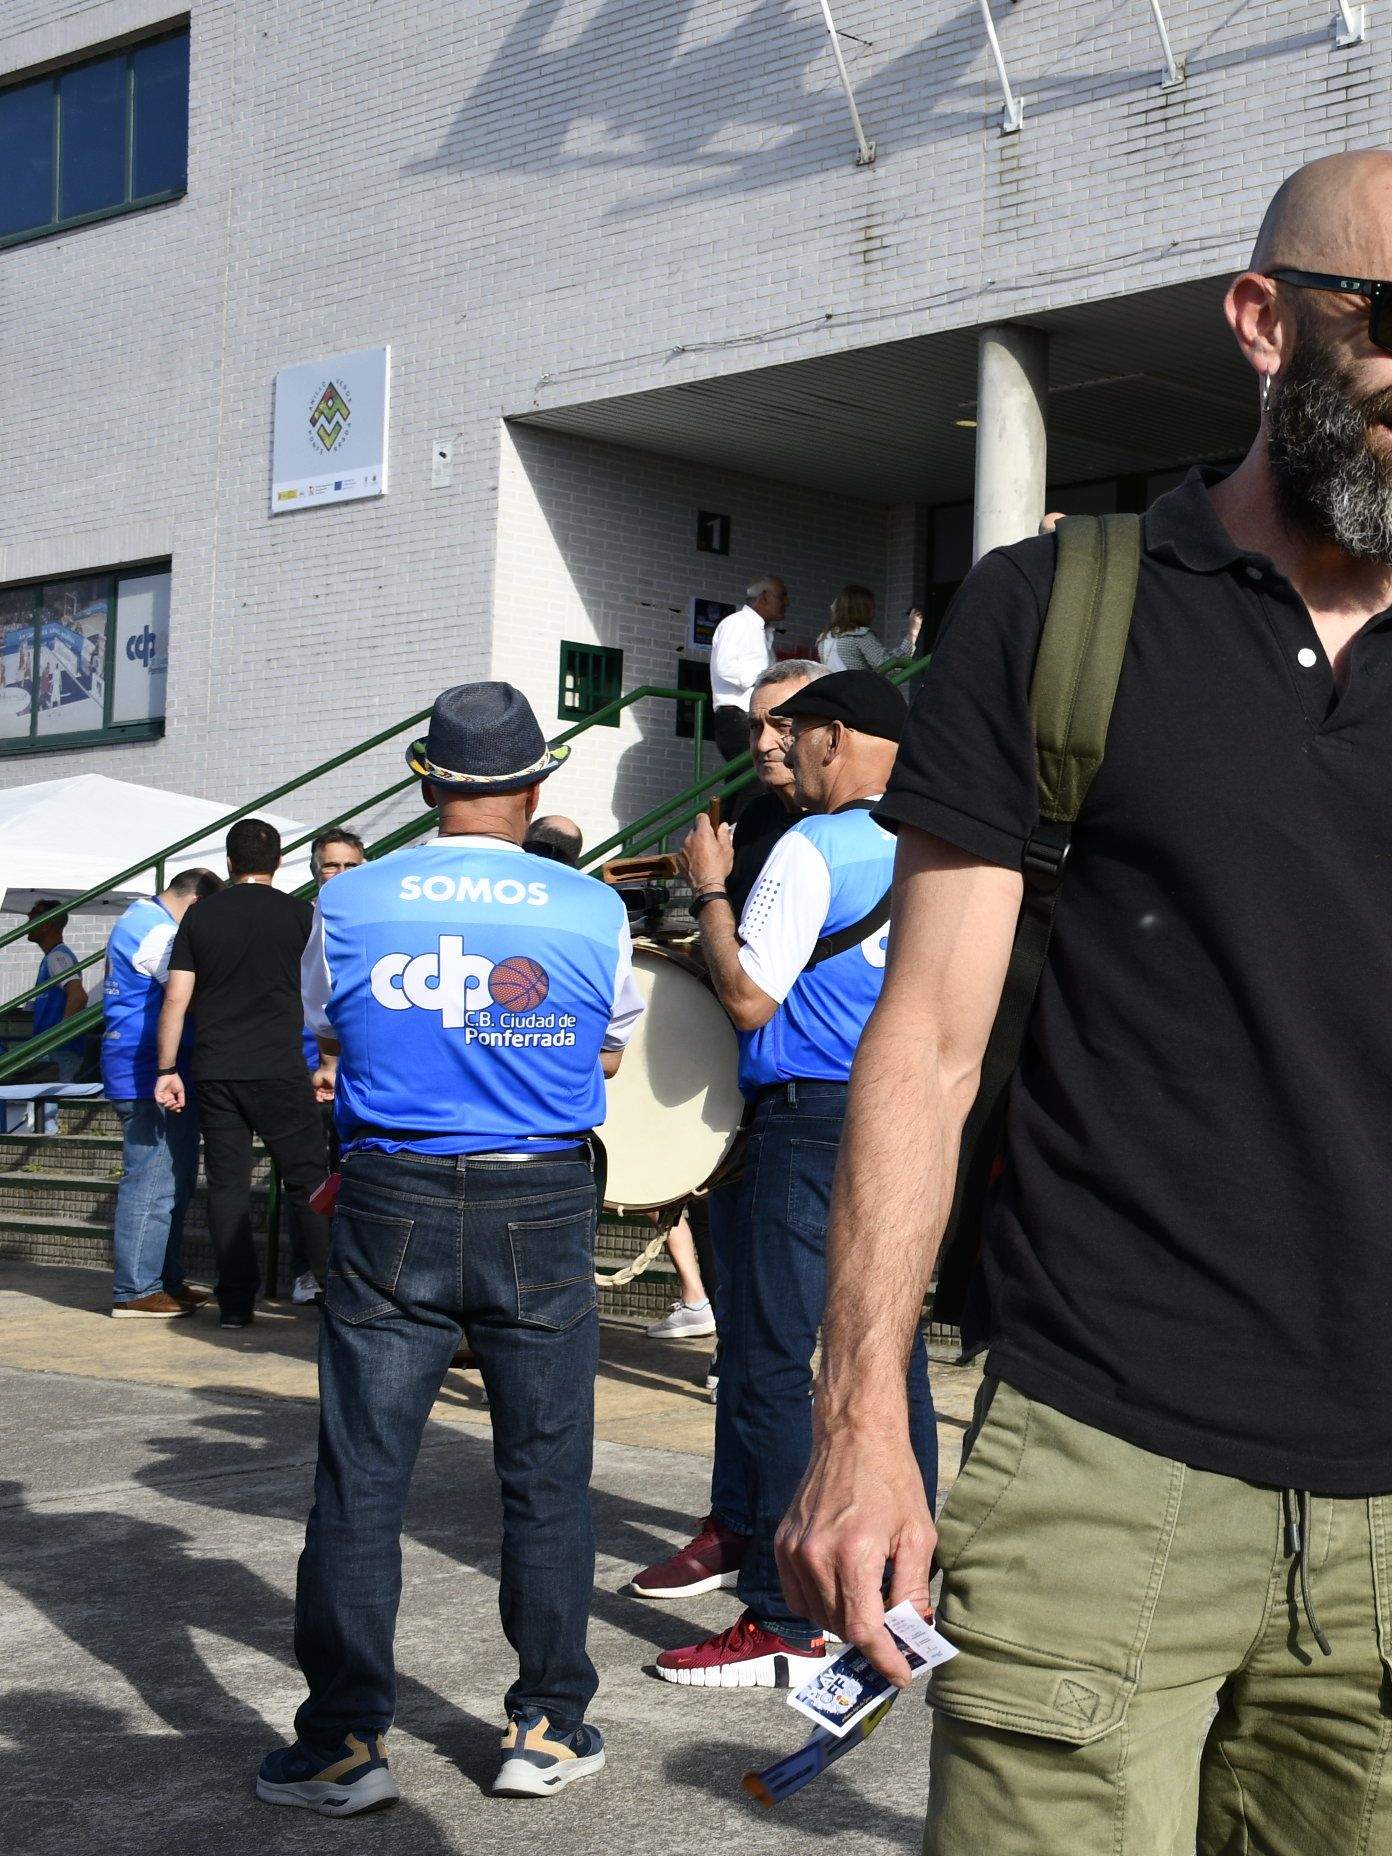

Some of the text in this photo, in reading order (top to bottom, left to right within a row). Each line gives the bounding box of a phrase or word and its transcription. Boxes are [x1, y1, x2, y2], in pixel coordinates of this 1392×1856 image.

[706, 518, 721, 550] 1
[399, 875, 549, 906] SOMOS
[464, 1012, 577, 1029] C.B. Ciudad de
[464, 1027, 576, 1048] Ponferrada
